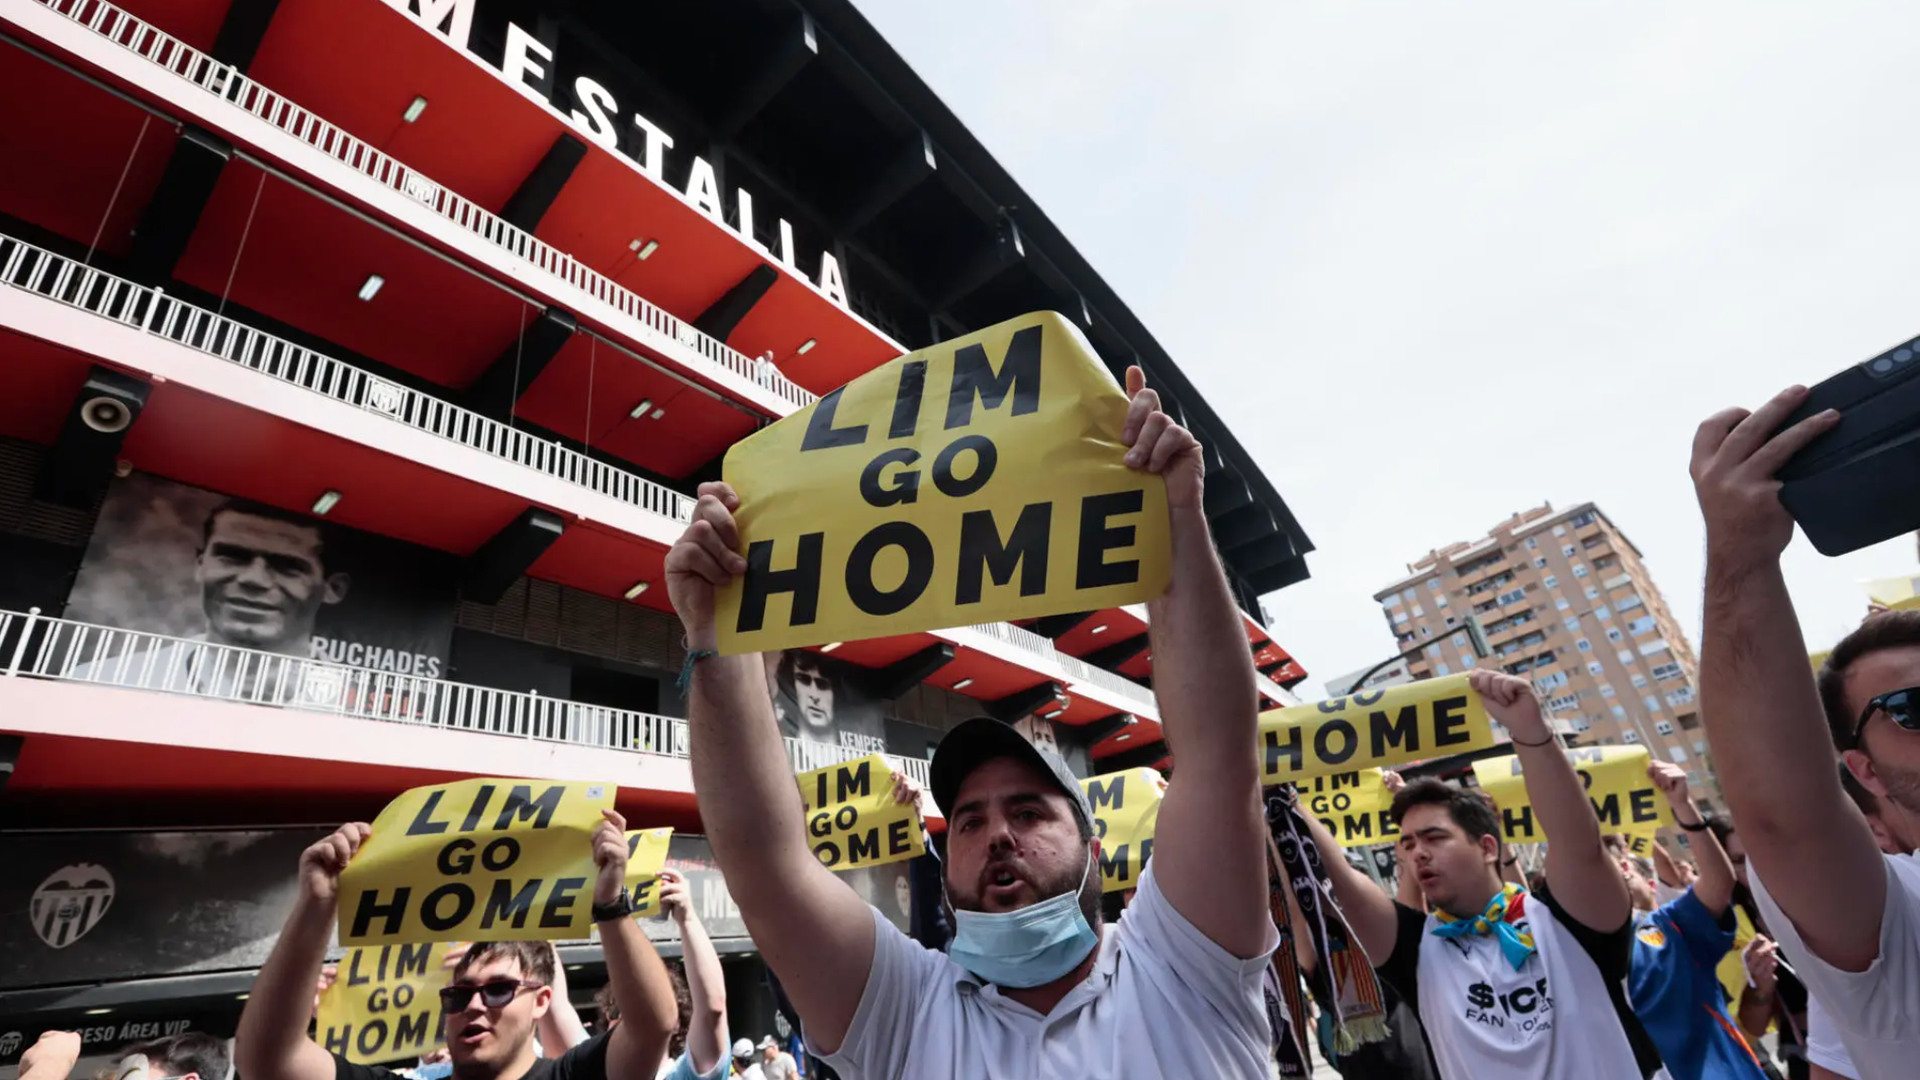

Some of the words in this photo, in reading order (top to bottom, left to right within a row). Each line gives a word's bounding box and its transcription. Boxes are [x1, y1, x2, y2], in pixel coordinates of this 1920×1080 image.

[800, 324, 1043, 452] LIM
[859, 434, 998, 508] GO
[735, 489, 1143, 633] HOME
[309, 635, 441, 680] RUCHADES
[839, 729, 885, 753] KEMPES
[1265, 695, 1471, 775] HOME
[804, 761, 871, 812] IM
[1311, 793, 1352, 814] GO
[405, 784, 567, 837] LIM
[810, 805, 858, 838] GO
[1319, 810, 1400, 841] OME
[1502, 788, 1659, 838] HME
[436, 836, 521, 876] GO
[812, 818, 911, 867] OME
[349, 876, 588, 938] HOME
[346, 943, 434, 987] LIM
[367, 983, 414, 1013] GO
[1466, 1008, 1504, 1028] FAN
[118, 1020, 160, 1040] ÁREA
[164, 1019, 191, 1036] VIP
